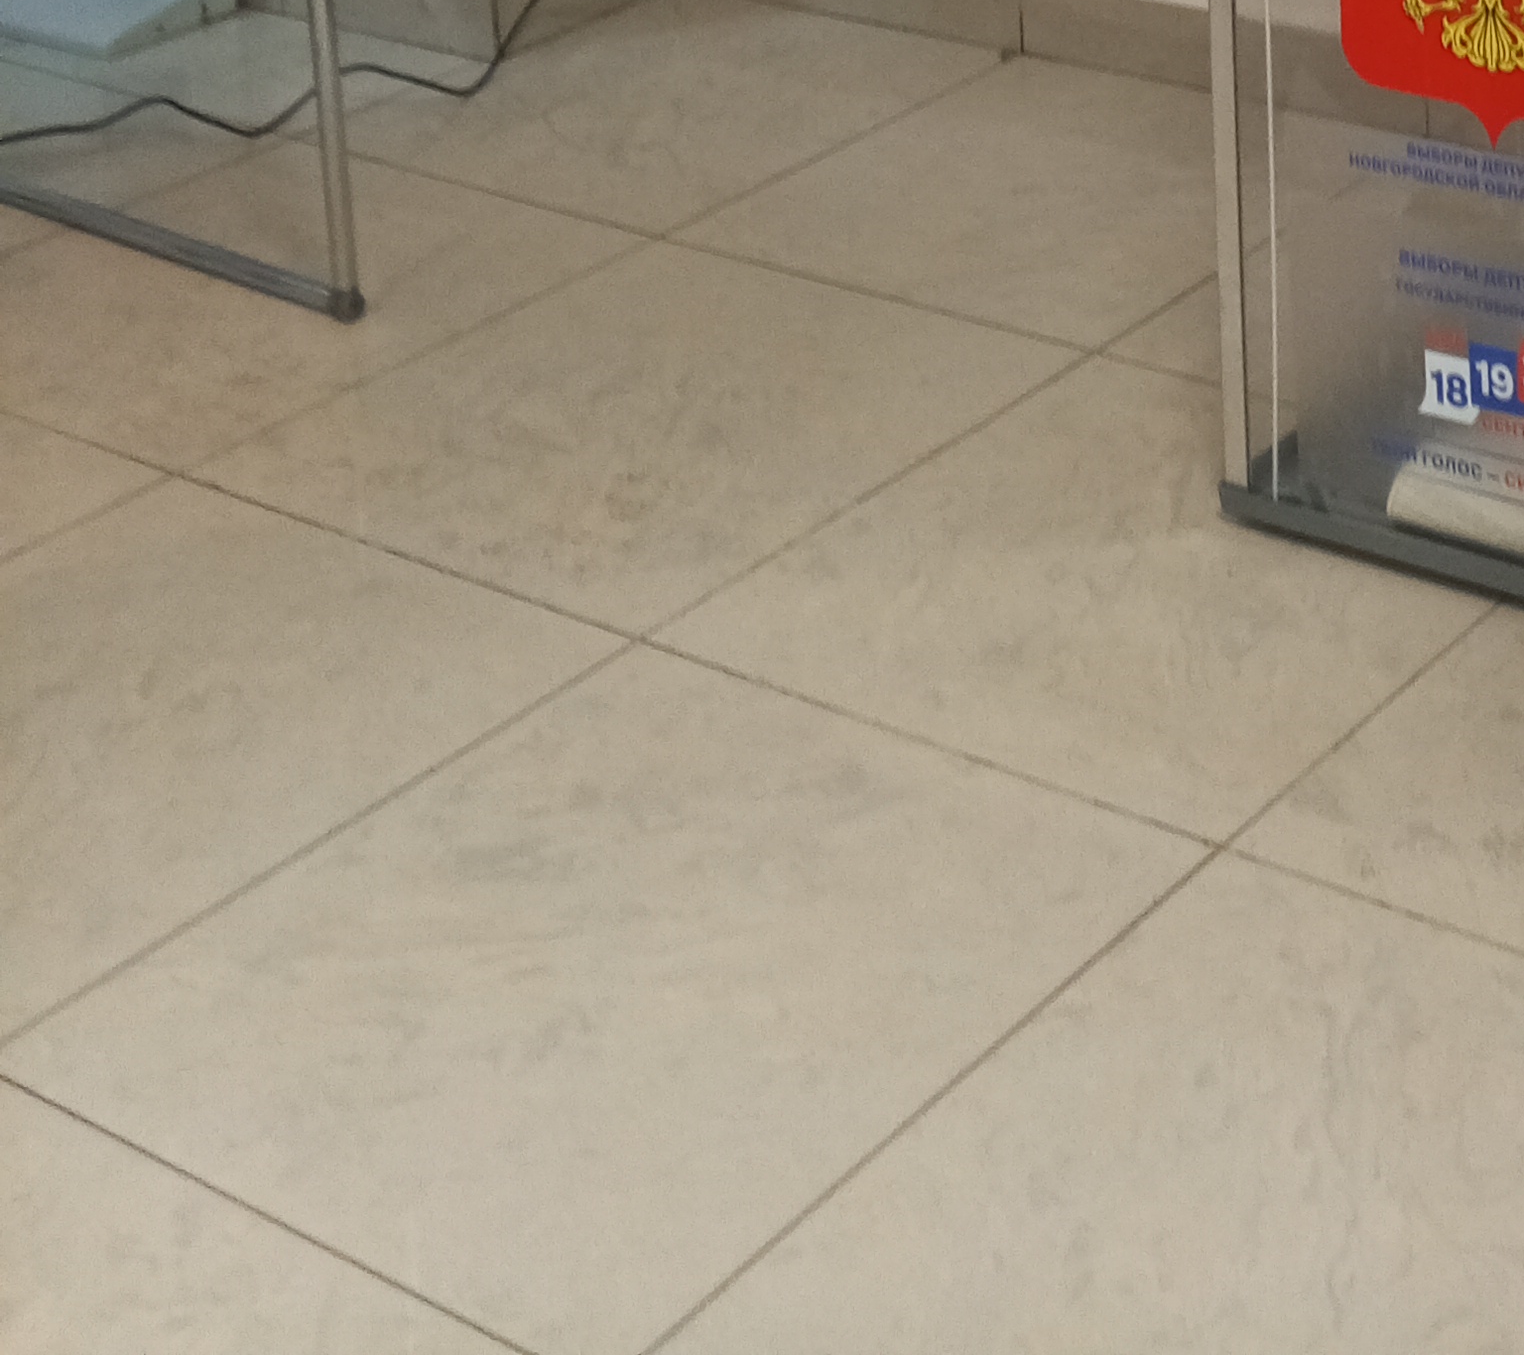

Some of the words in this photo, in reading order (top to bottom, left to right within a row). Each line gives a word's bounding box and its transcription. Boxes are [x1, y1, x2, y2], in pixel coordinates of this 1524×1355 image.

[1349, 151, 1480, 192] НОВГОРОДСКОЙ
[1406, 142, 1477, 169] ВЫБОРЫ
[1399, 249, 1479, 281] ВЫБОРЫ
[1430, 368, 1468, 408] 18
[1475, 359, 1514, 401] 19
[1420, 449, 1482, 481] ГОЛОС
